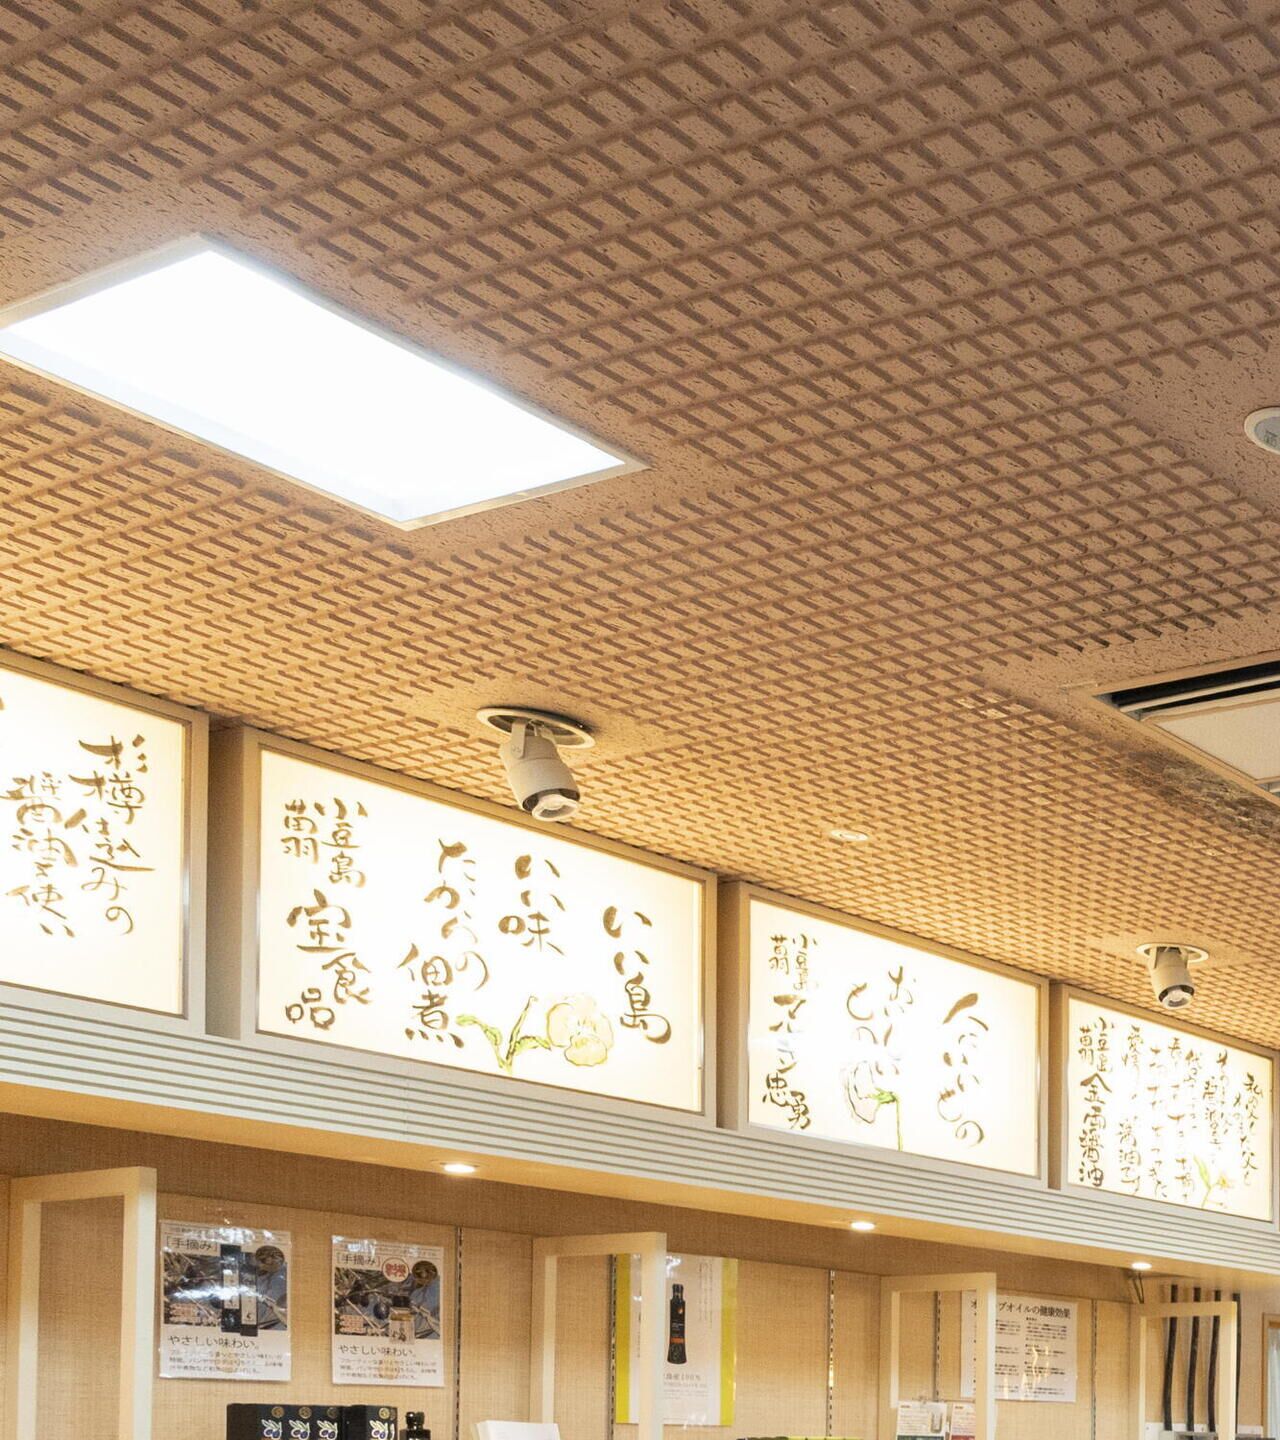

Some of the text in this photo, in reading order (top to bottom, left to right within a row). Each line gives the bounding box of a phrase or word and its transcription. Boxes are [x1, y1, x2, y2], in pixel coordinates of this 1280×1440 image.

[498, 854, 567, 957] いい味
[602, 905, 672, 1046] いい島
